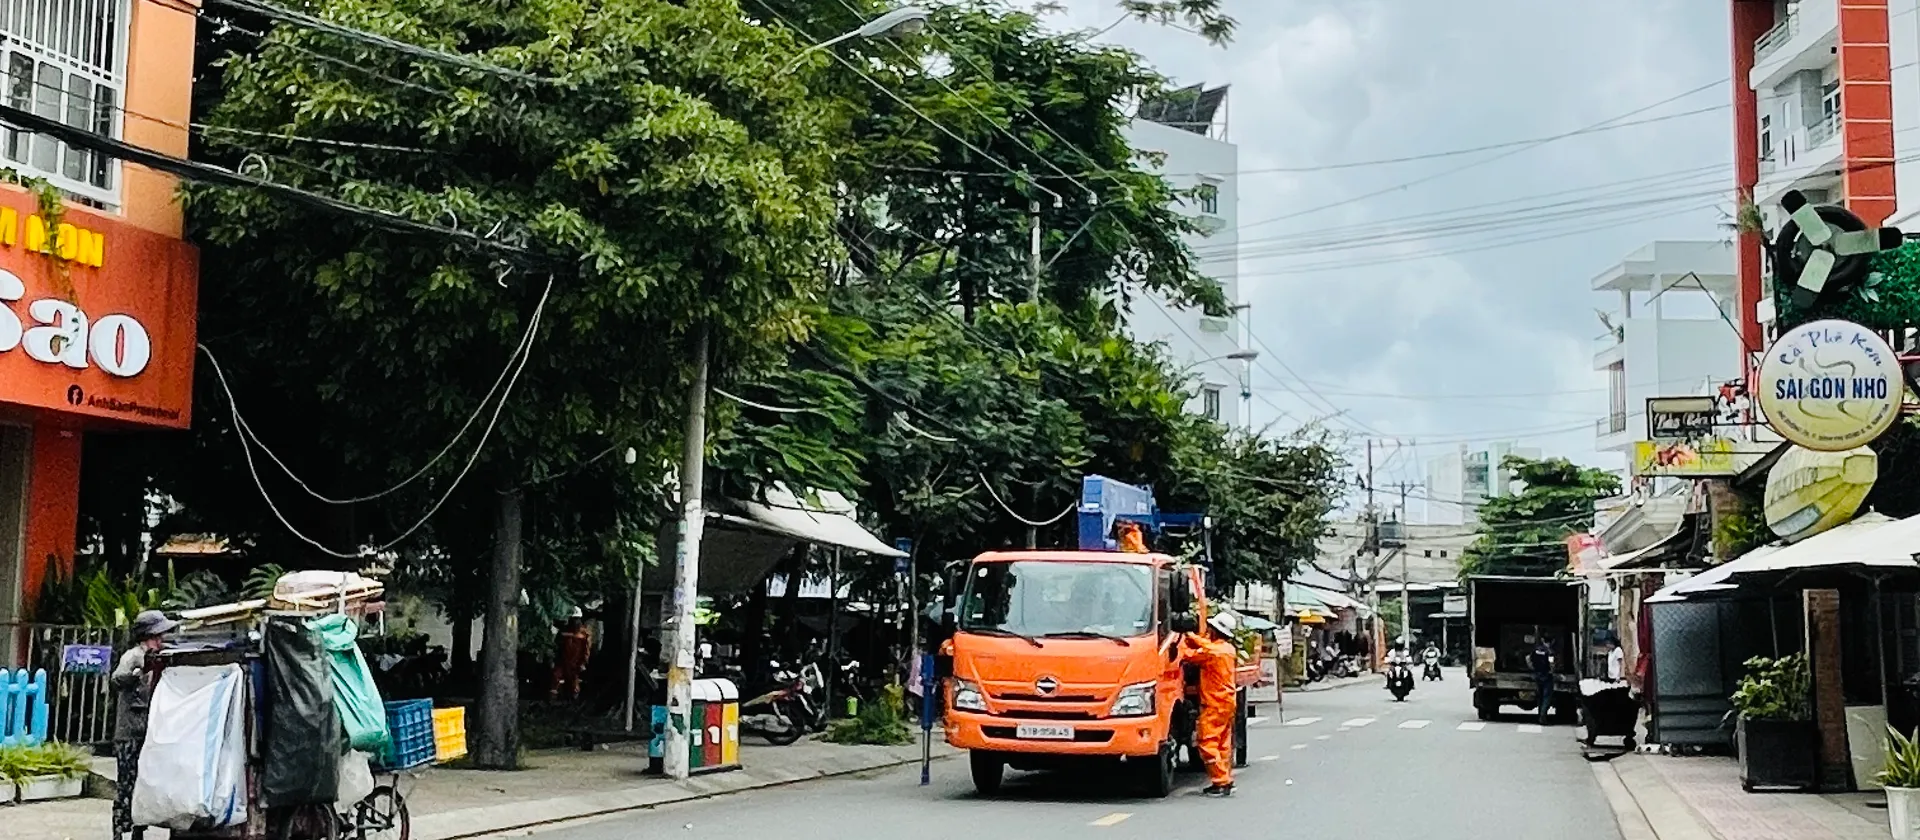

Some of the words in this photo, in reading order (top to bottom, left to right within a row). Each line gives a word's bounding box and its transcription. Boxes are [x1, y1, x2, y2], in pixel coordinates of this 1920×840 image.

[1850, 332, 1884, 367] Kem
[1775, 373, 1803, 400] SÀI
[1809, 372, 1845, 400] GÒN
